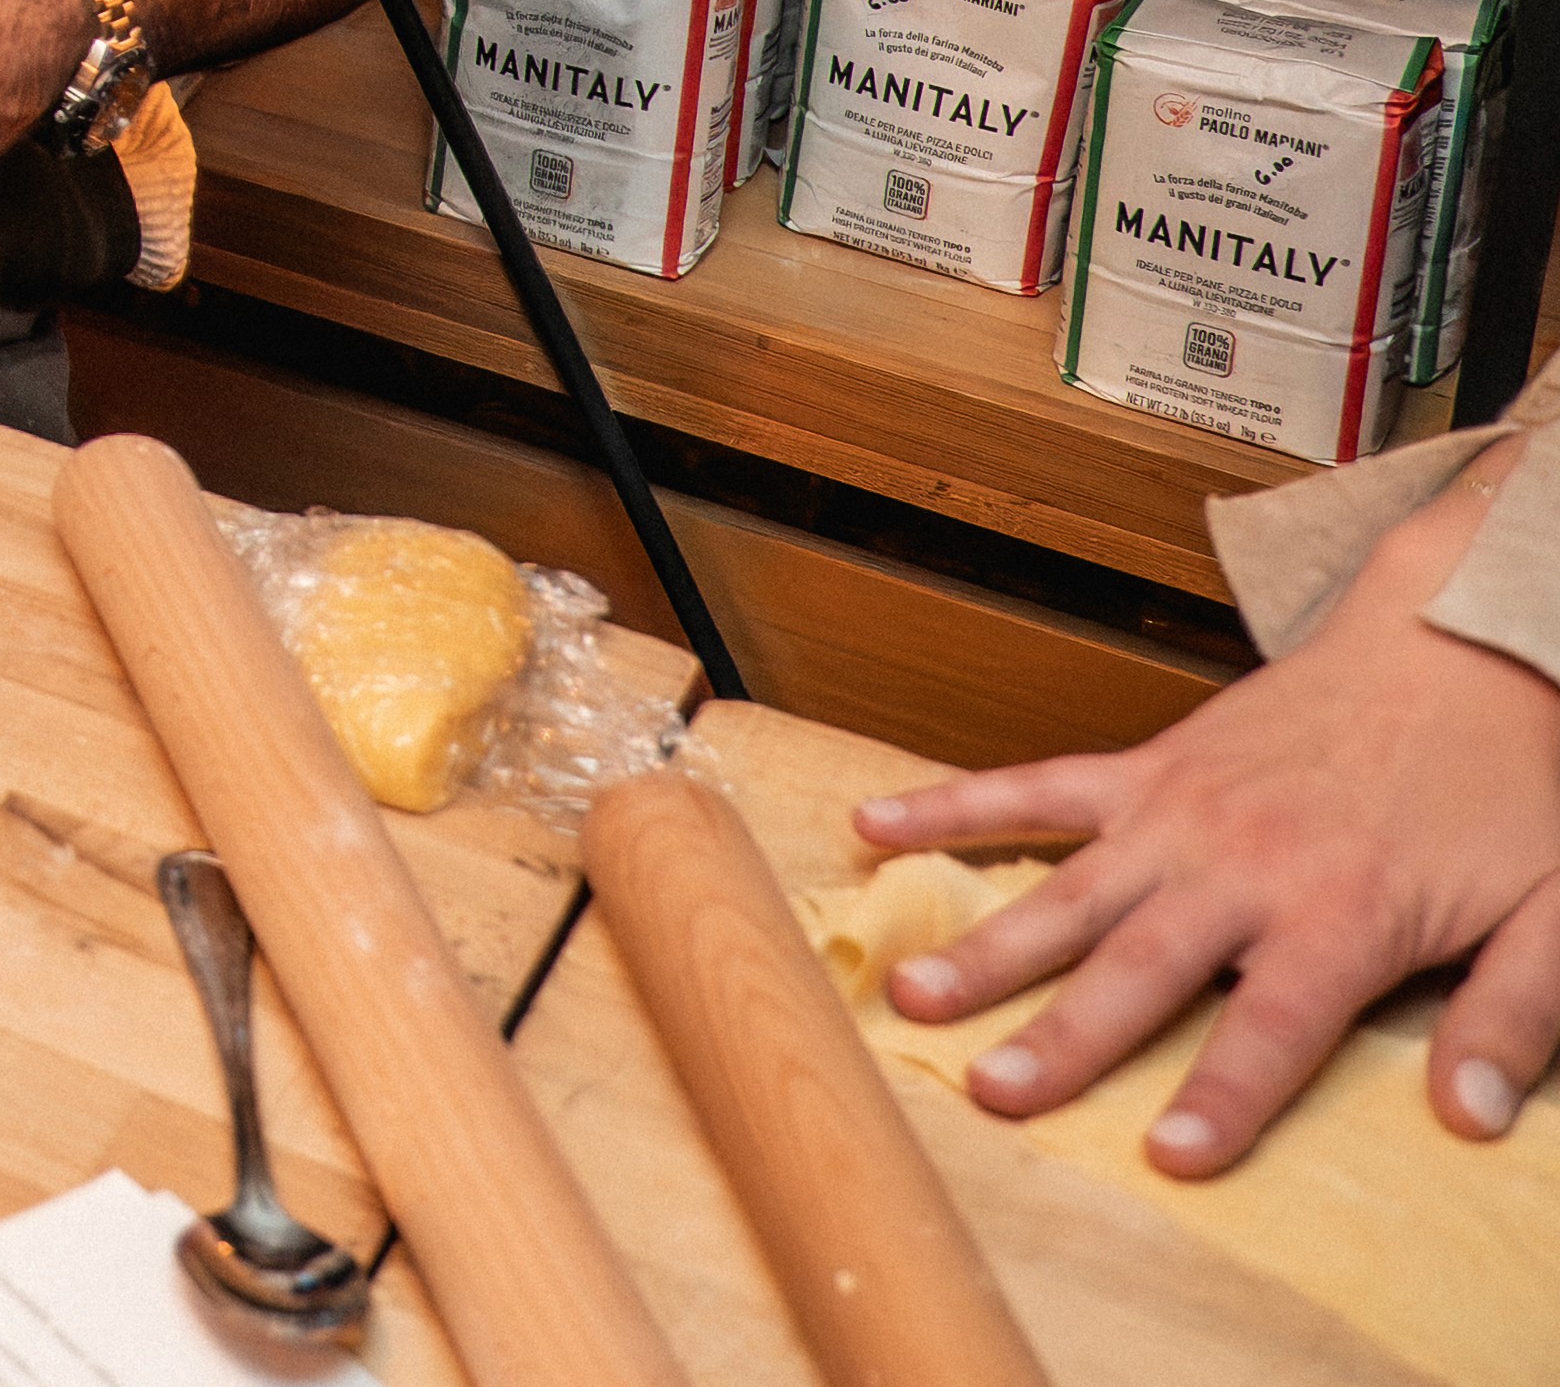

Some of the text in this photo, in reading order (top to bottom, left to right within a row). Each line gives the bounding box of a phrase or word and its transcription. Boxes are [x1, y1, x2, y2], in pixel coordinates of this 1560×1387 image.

[961, 45, 1005, 73] Manitoba
[475, 36, 660, 112] MANITALY
[828, 54, 1028, 137] MANITALY
[1201, 104, 1251, 123] molino
[1199, 117, 1249, 140] PAOLO
[891, 175, 925, 195] 100%
[889, 187, 924, 206] GRANO
[1167, 174, 1309, 220] forza della farina Manitoba
[1178, 190, 1206, 202] gusto
[1208, 193, 1223, 205] dei
[1225, 198, 1252, 212] grani
[1115, 200, 1338, 288] MANITALY
[1136, 259, 1171, 277] IDEALE
[1174, 269, 1194, 283] PER
[1228, 286, 1258, 301] PIZZA
[1269, 297, 1303, 313] DOLCI
[1168, 280, 1203, 299] LUNGA
[1191, 328, 1229, 350] 100%
[1187, 354, 1227, 372] ITALIANO
[1189, 342, 1228, 362] GRANO
[1129, 364, 1162, 382] FARINA
[1174, 378, 1208, 396] GRANO
[1250, 399, 1272, 412] TIPO
[1125, 392, 1145, 407] NET
[1125, 375, 1282, 426] HIGH PROTEIN SOFT WHEAT FLOUR
